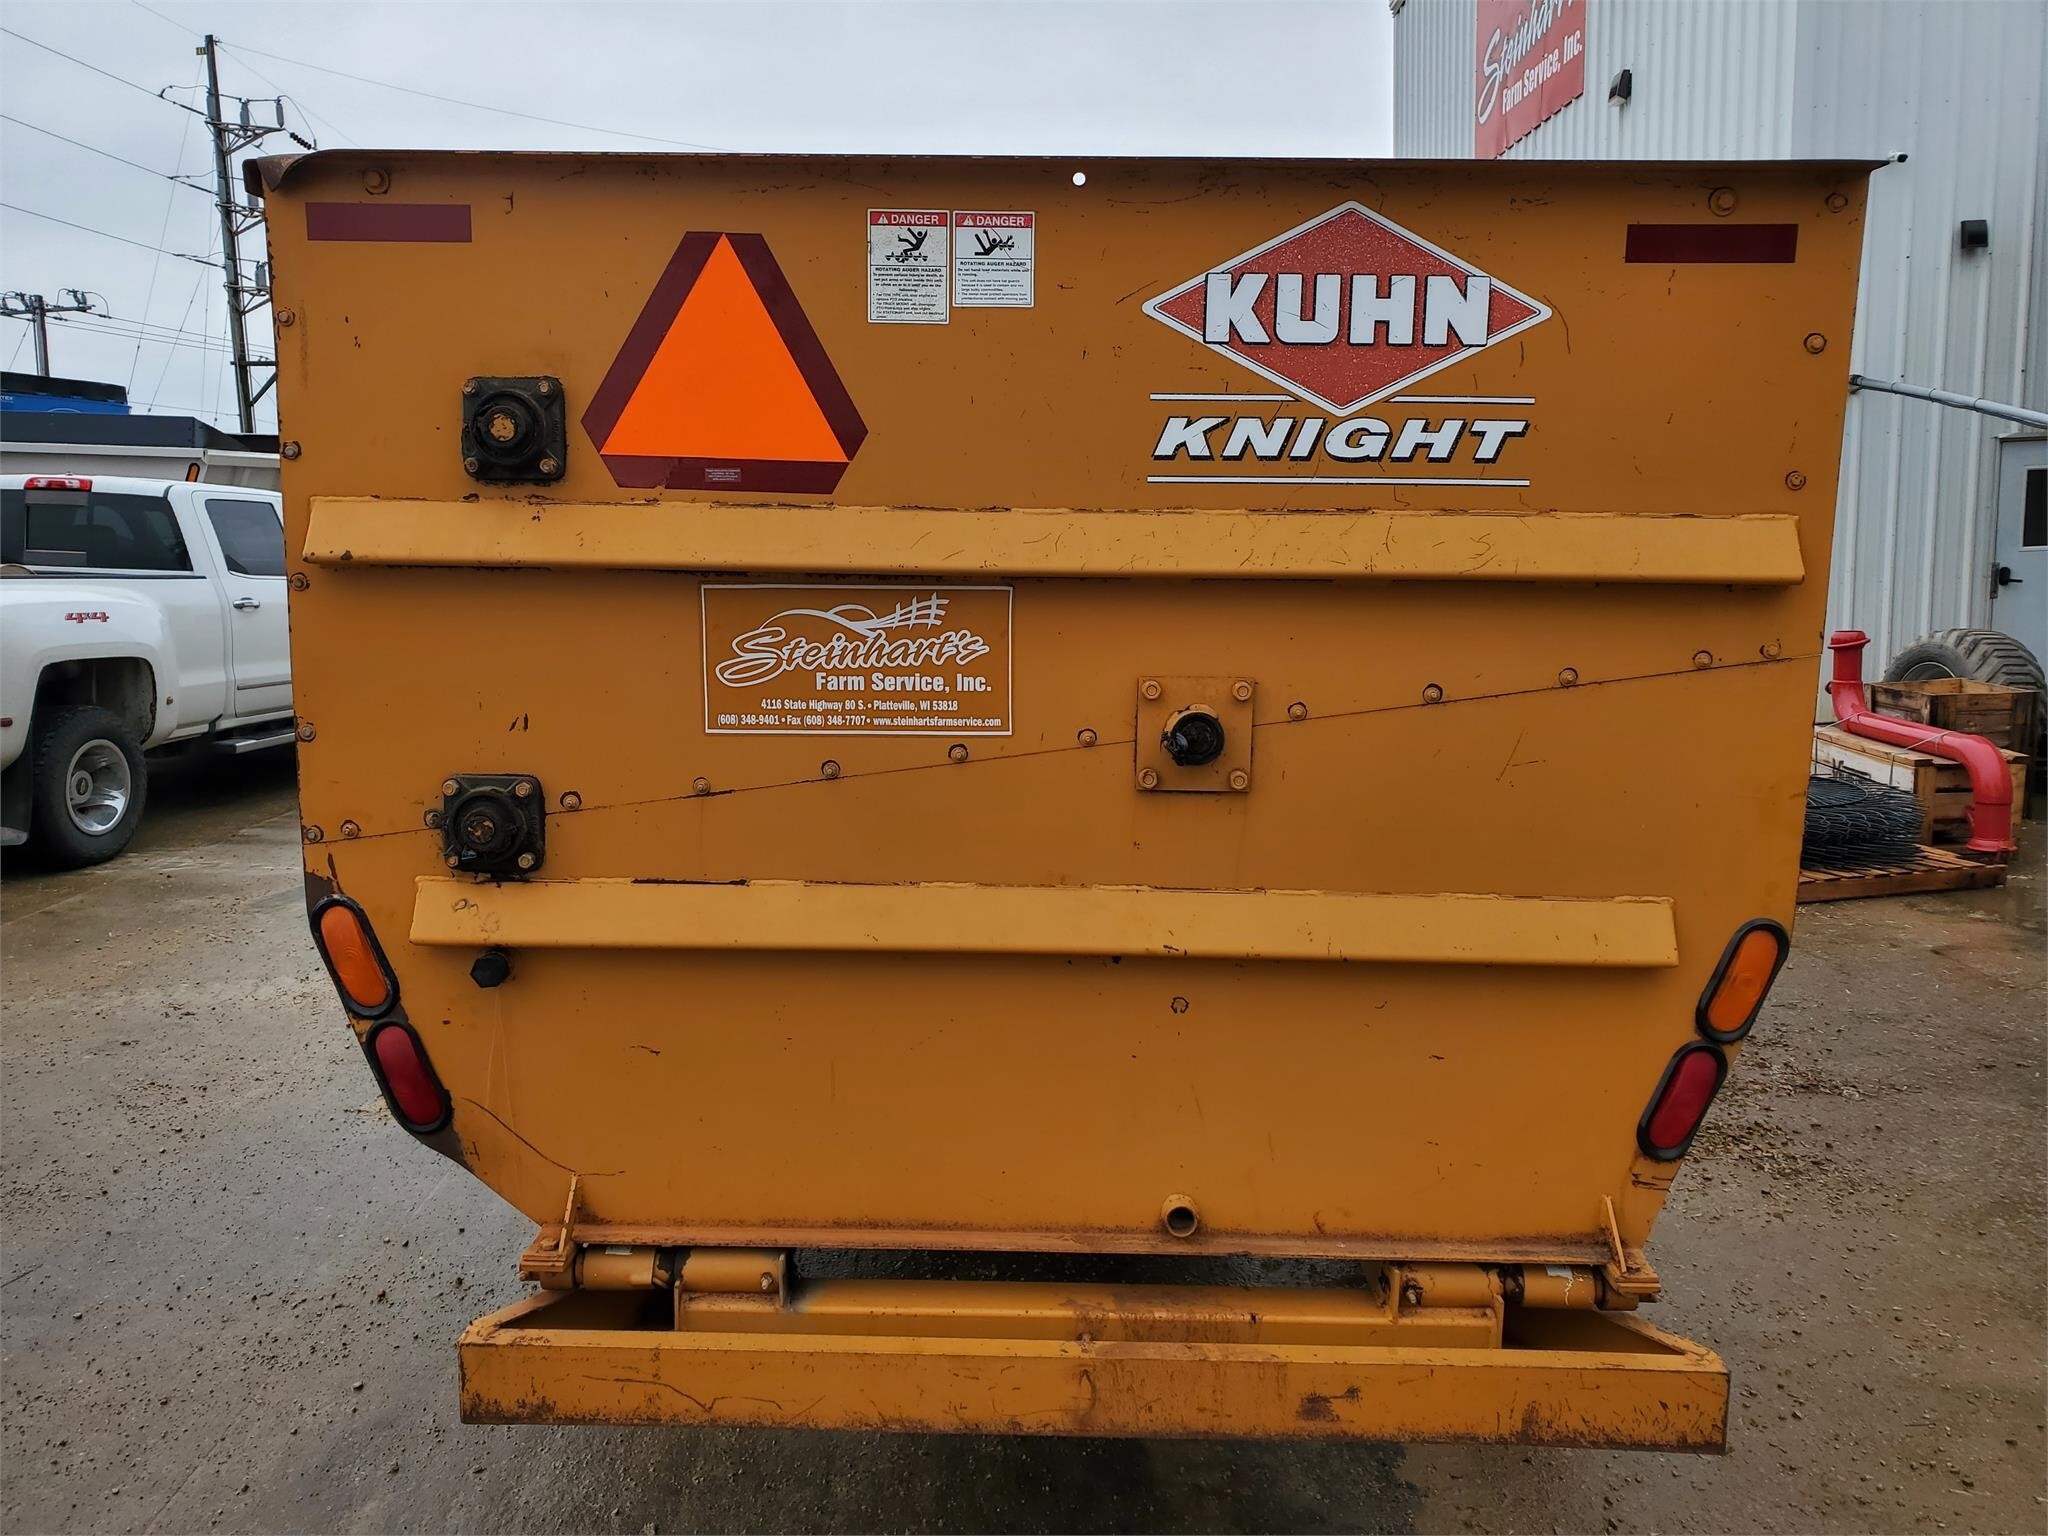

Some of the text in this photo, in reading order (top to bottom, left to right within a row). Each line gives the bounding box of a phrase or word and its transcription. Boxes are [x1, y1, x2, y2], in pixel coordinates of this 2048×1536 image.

[1477, 0, 1572, 124] Steinhar
[1502, 30, 1583, 115] Farm Service, Inc.
[891, 214, 940, 225] DANGER
[976, 216, 1025, 227] DANGER
[1203, 272, 1492, 346] KUHN
[1152, 416, 1530, 463] KNIGHT
[715, 626, 990, 687] Steinhart's
[816, 672, 992, 694] Farm Service, Inc.
[717, 714, 739, 727] (608)
[803, 715, 825, 727] (608)
[873, 716, 1002, 727] www.steinhartsfarmservice.com
[761, 699, 782, 710] 4116
[784, 699, 807, 710] State
[808, 699, 843, 712] Highway
[845, 700, 857, 710] 80
[873, 700, 918, 712] Platteville,
[920, 701, 930, 711] WI
[932, 700, 958, 711] 53818
